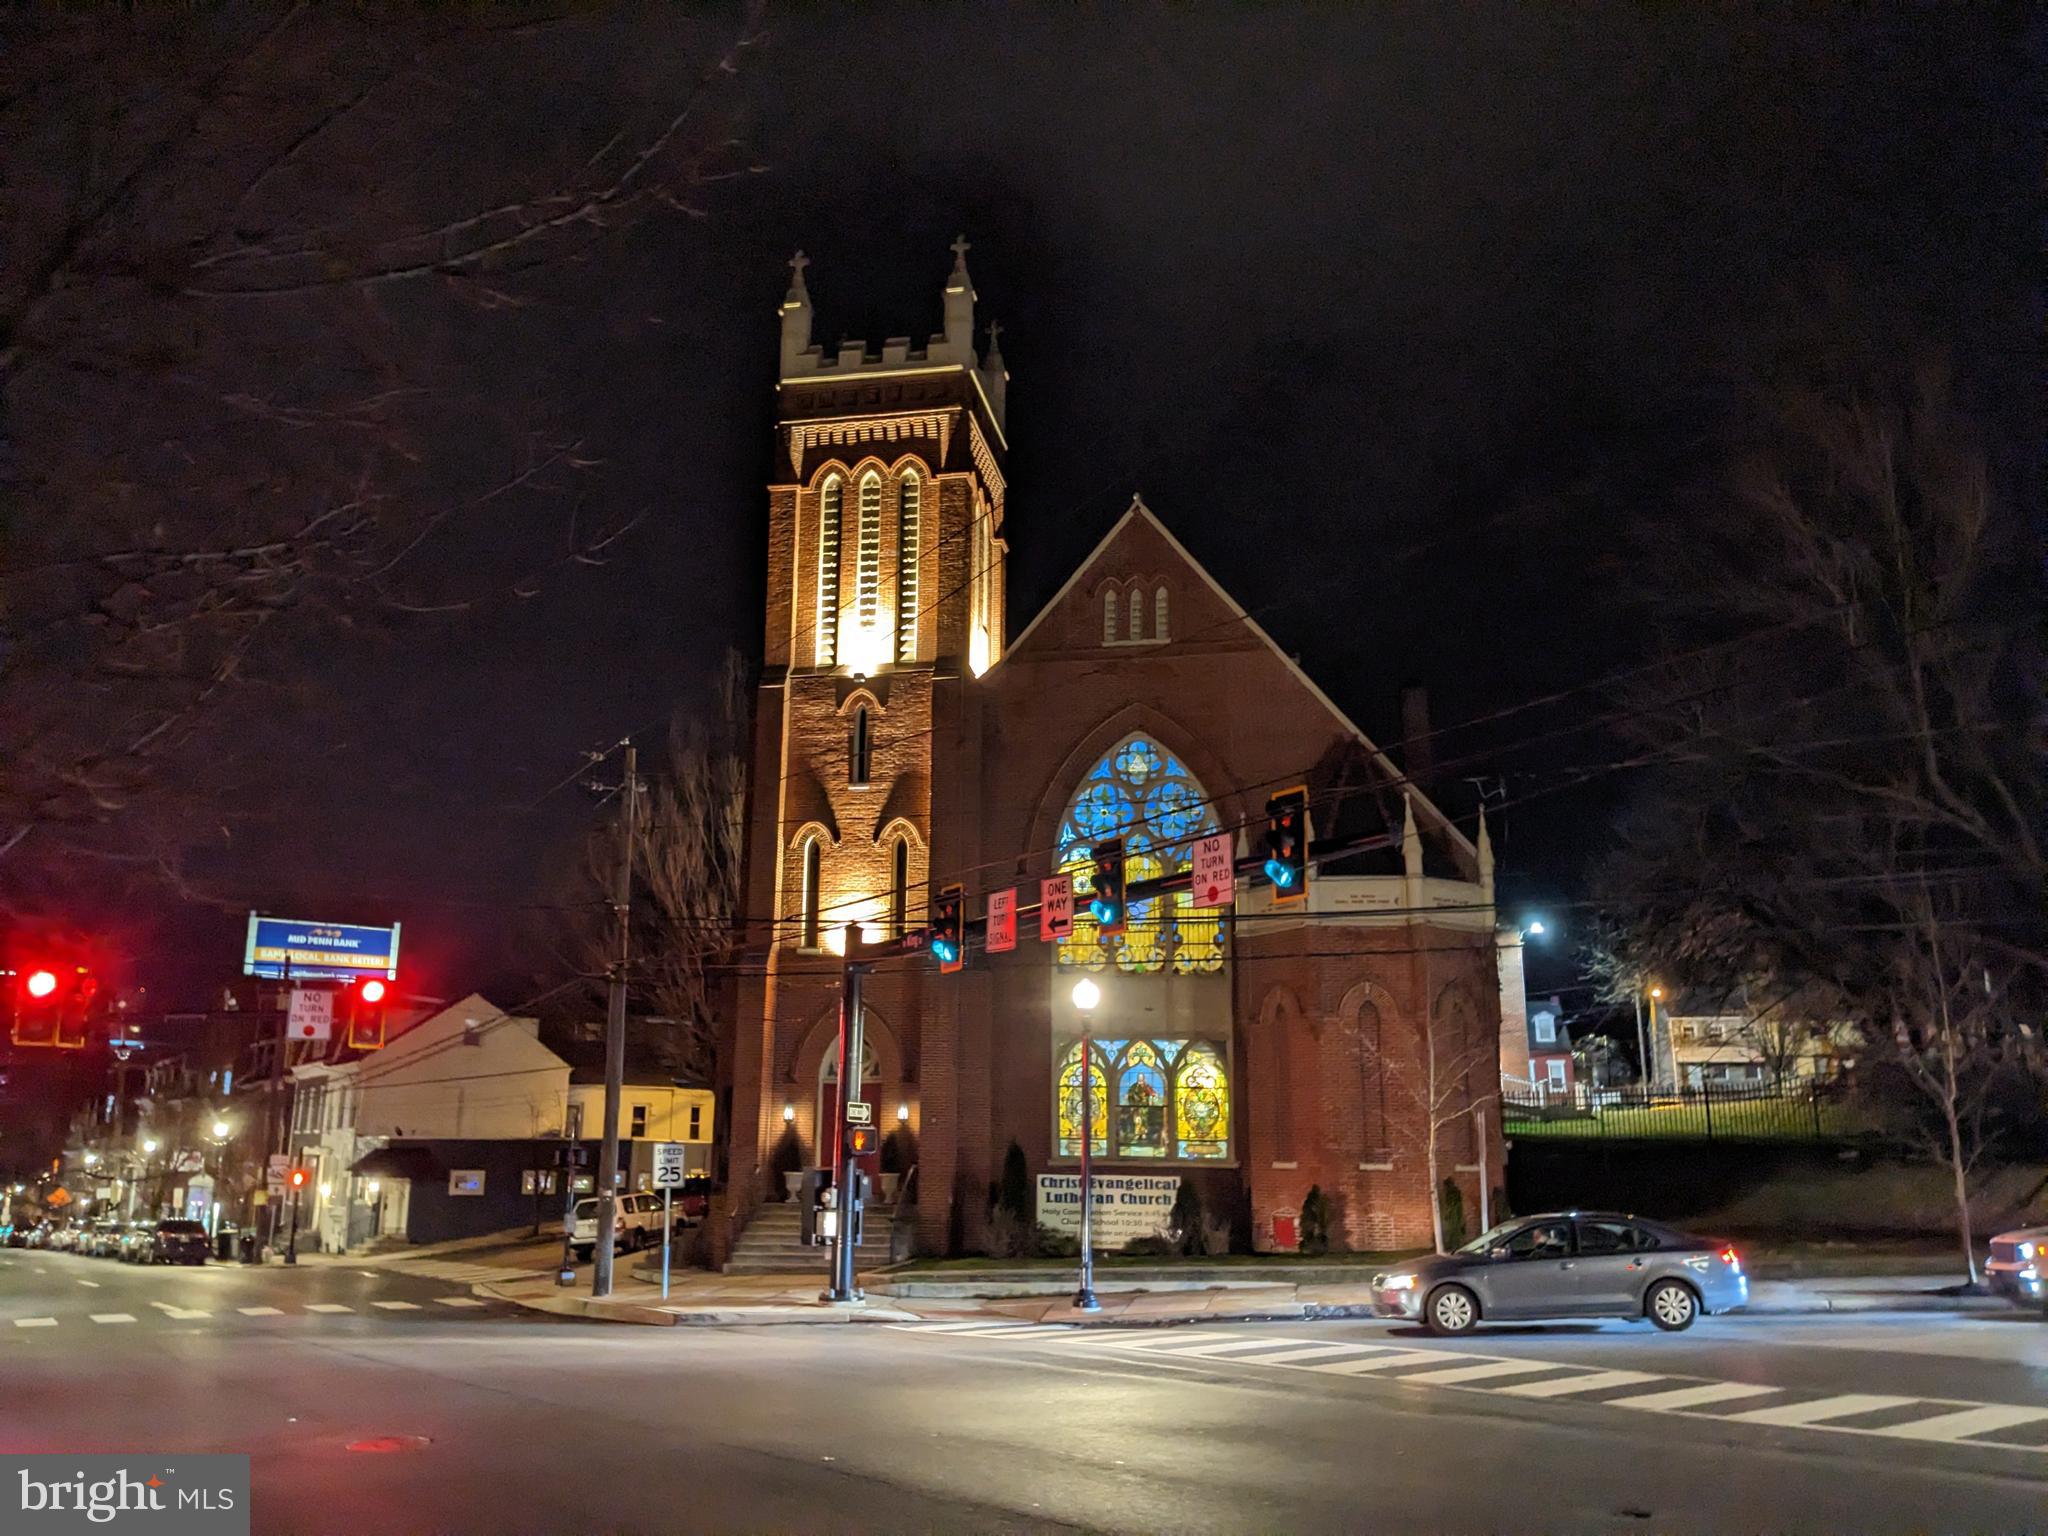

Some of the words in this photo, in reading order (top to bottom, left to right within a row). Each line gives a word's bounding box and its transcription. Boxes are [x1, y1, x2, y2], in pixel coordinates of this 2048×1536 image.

[1203, 839, 1220, 853] NO
[1201, 855, 1224, 869] TURN
[1195, 873, 1208, 886] ON
[1212, 868, 1230, 881] RED
[1047, 880, 1067, 897] ONE
[1047, 897, 1068, 913] WAY
[287, 934, 307, 944] MID
[307, 937, 333, 947] PENN
[333, 939, 359, 949] BANK
[323, 953, 350, 964] BANK
[304, 993, 322, 1002] NO
[299, 1003, 324, 1012] TURN
[291, 1014, 305, 1023] ON
[310, 1015, 330, 1024] RED
[657, 1148, 683, 1156] SPEED
[658, 1166, 681, 1182] 25
[1090, 1178, 1178, 1190] Evangelical
[1045, 1192, 1114, 1204] Luthran
[1119, 1193, 1172, 1205] Church
[1042, 1208, 1061, 1216] Holy
[1062, 1208, 1112, 1217] Comnion
[1091, 1218, 1119, 1226] School
